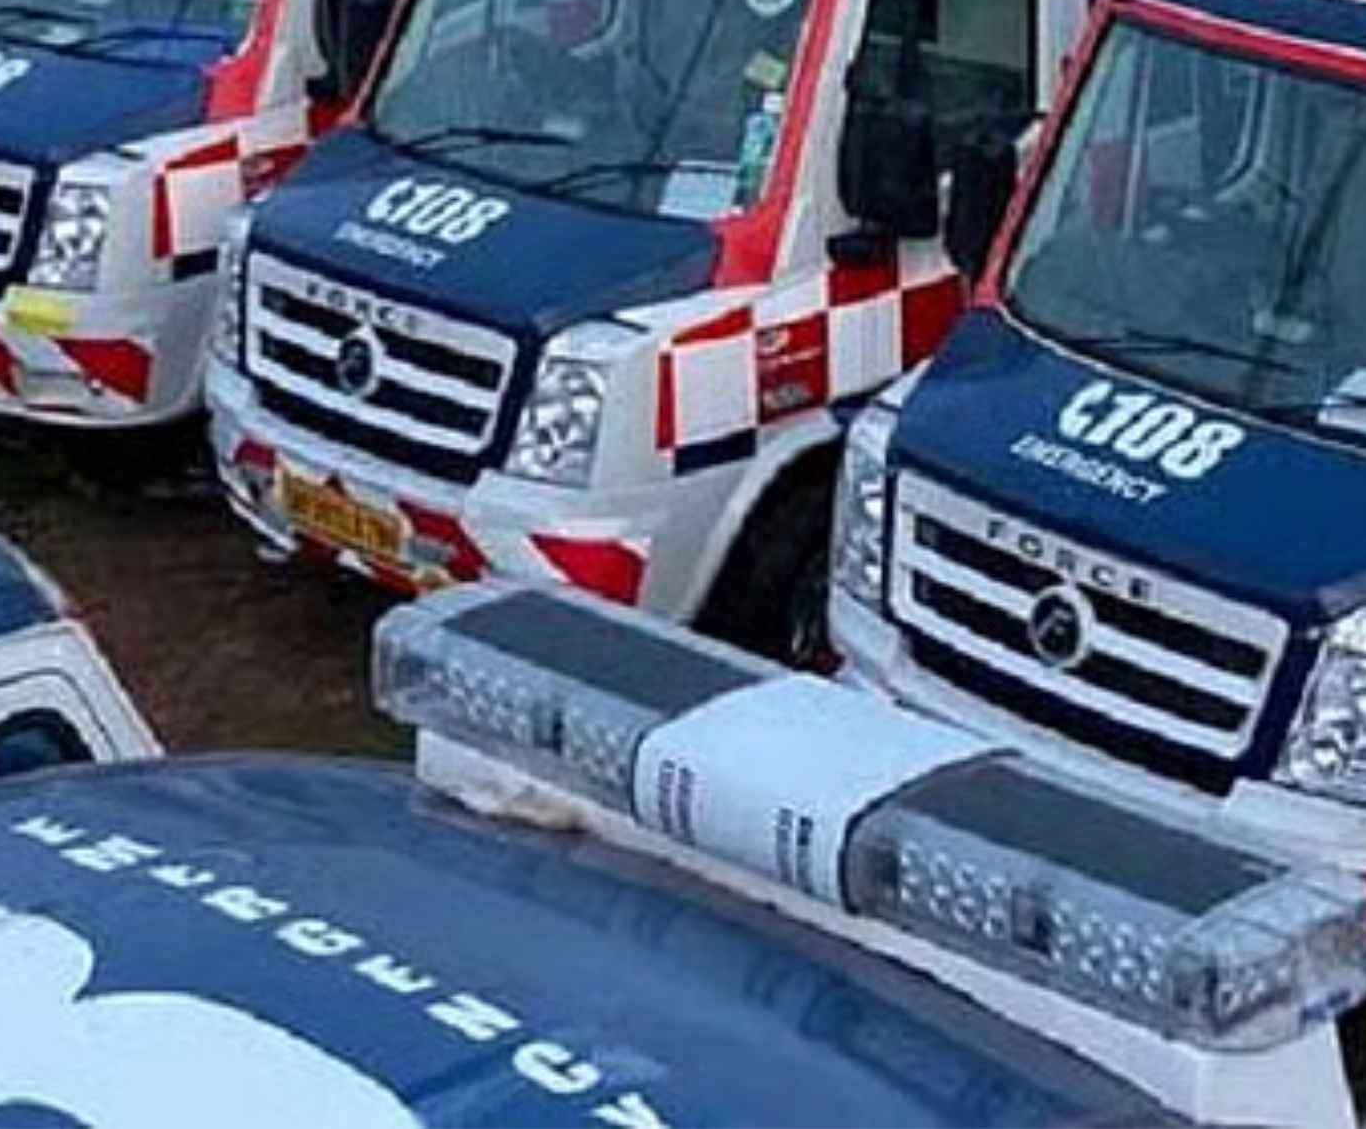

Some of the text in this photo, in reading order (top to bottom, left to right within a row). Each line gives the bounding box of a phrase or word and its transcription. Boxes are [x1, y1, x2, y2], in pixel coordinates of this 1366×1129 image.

[386, 183, 511, 245] 108
[1009, 433, 1169, 504] EMERGENCY
[1082, 393, 1248, 480] 108
[987, 519, 1153, 601] FORCE
